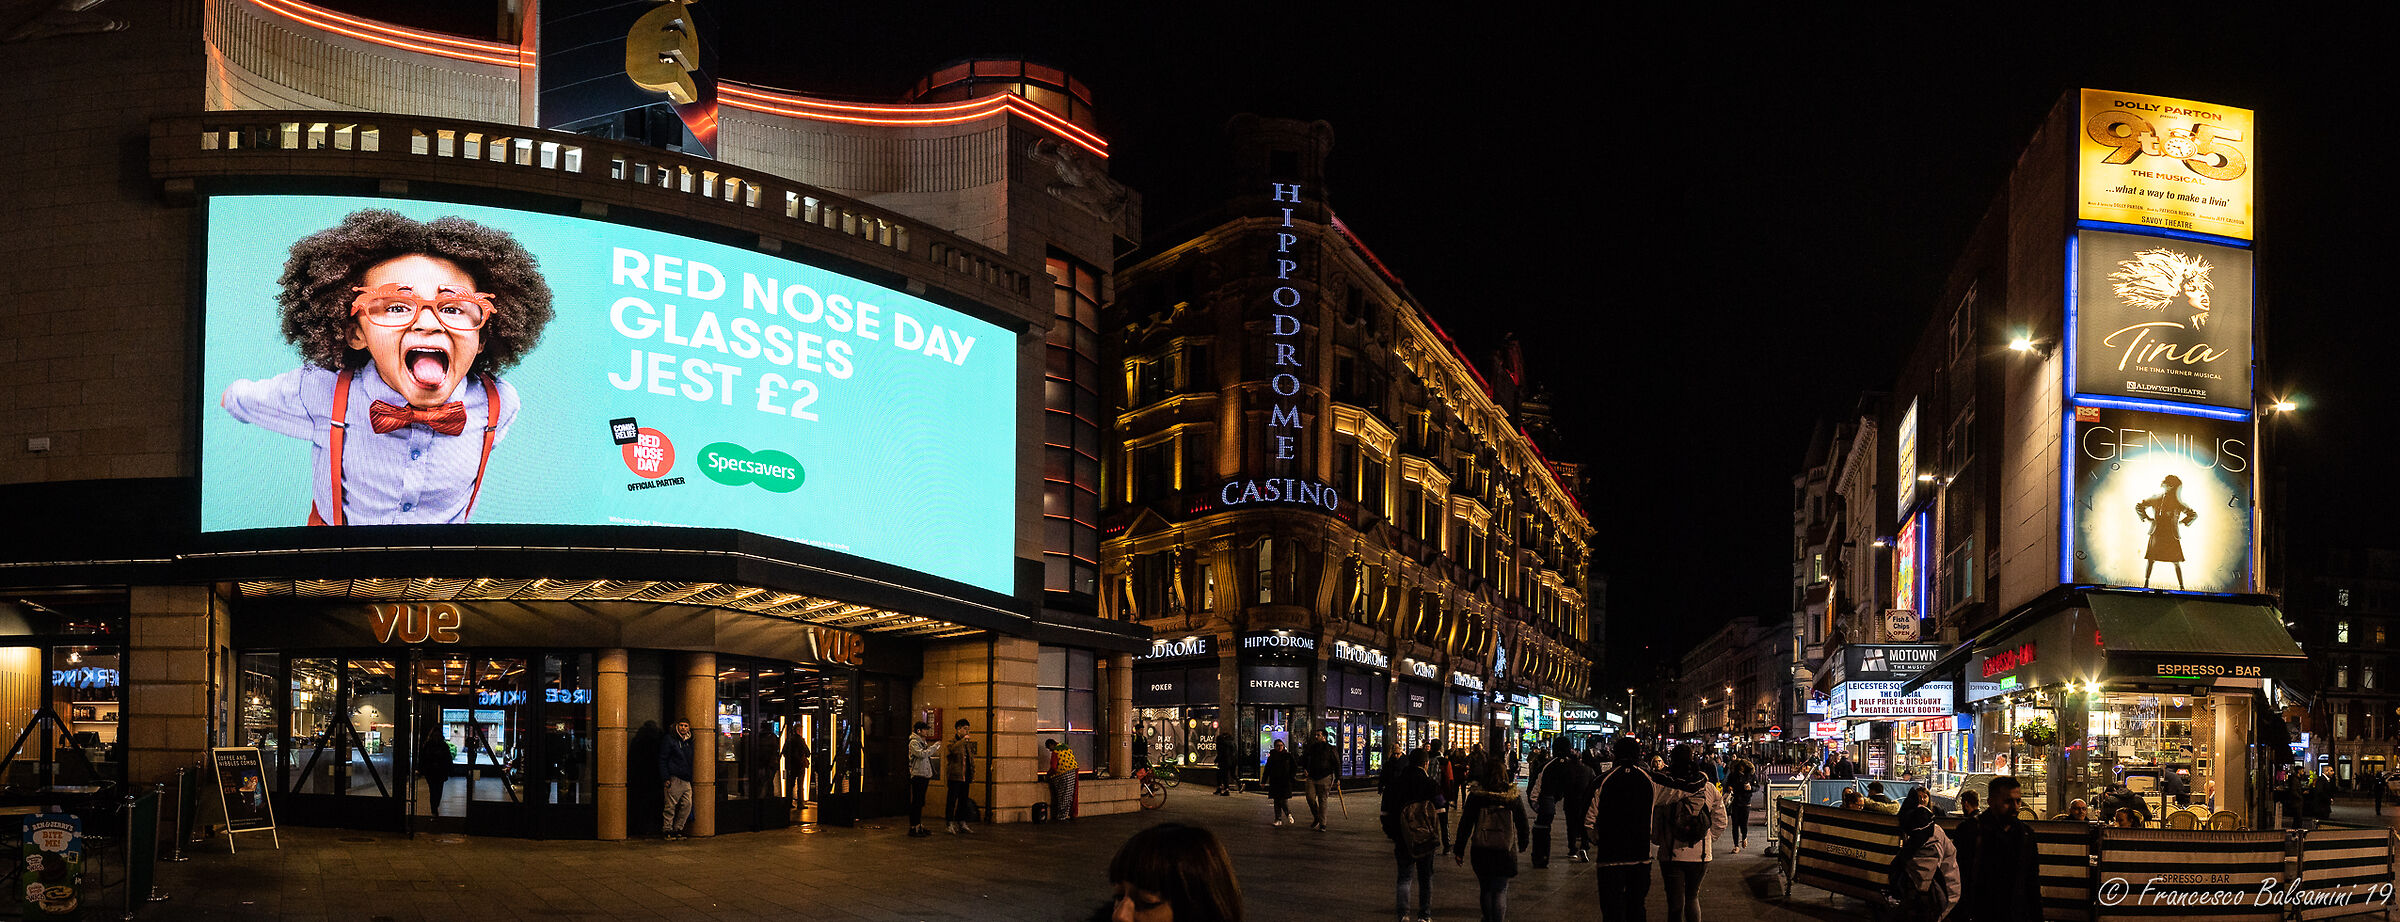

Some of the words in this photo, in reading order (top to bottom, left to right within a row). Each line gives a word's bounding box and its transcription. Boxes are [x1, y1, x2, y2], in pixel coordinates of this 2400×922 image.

[2114, 100, 2161, 113] DOLLY
[2164, 105, 2222, 121] PARTON
[2087, 110, 2157, 165] 9
[2183, 123, 2248, 181] 5
[2131, 169, 2154, 179] THE
[2156, 172, 2206, 186] MUSICAL
[2139, 188, 2145, 196] a
[2147, 189, 2165, 200] way
[2166, 191, 2175, 200] to
[2177, 192, 2199, 204] make
[2201, 196, 2207, 204] a
[2141, 216, 2162, 225] SAVOY
[2165, 219, 2193, 229] THEATRE
[612, 246, 726, 300] RED
[743, 272, 879, 341] NOSE
[894, 311, 976, 367] DAY
[1269, 182, 1303, 460] HIPPODROME
[609, 296, 854, 380] GLASSES
[2104, 321, 2229, 371] Tina
[2194, 372, 2222, 380] MUSICAL
[608, 349, 742, 406] JEST
[756, 372, 819, 422] £2
[2077, 407, 2098, 416] RSC
[613, 423, 636, 432] COMIC
[614, 430, 636, 440] RELIEF
[638, 434, 660, 448] RED
[633, 445, 663, 461] NOSE
[2083, 426, 2246, 473] GENIUS
[637, 458, 660, 472] DAY
[708, 451, 796, 480] Specsavers
[627, 480, 656, 491] OFFICIAL
[656, 476, 686, 487] PARTNER
[1221, 478, 1338, 511] CASINO
[1244, 635, 1315, 650] HIPPODROME
[1336, 643, 1388, 669] HIPPODROME
[1889, 649, 1937, 662] MOTOWN
[1413, 663, 1436, 679] CASINO
[2157, 664, 2225, 677] ESPRESSO
[2235, 665, 2261, 677] BAR
[1151, 683, 1173, 692] POKER
[1250, 680, 1300, 689] ENTRANCE
[1849, 682, 1888, 690] LEICESTER
[1880, 690, 1892, 698] THE
[1893, 690, 1921, 698] OCIAL
[1563, 710, 1599, 719] CASINO
[1197, 742, 1217, 750] POKER
[1200, 735, 1214, 743] PLAY
[42, 831, 63, 839] BITE
[45, 839, 61, 847] ME!
[2156, 874, 2203, 884] ESPRESSO
[2211, 874, 2230, 884] BAR
